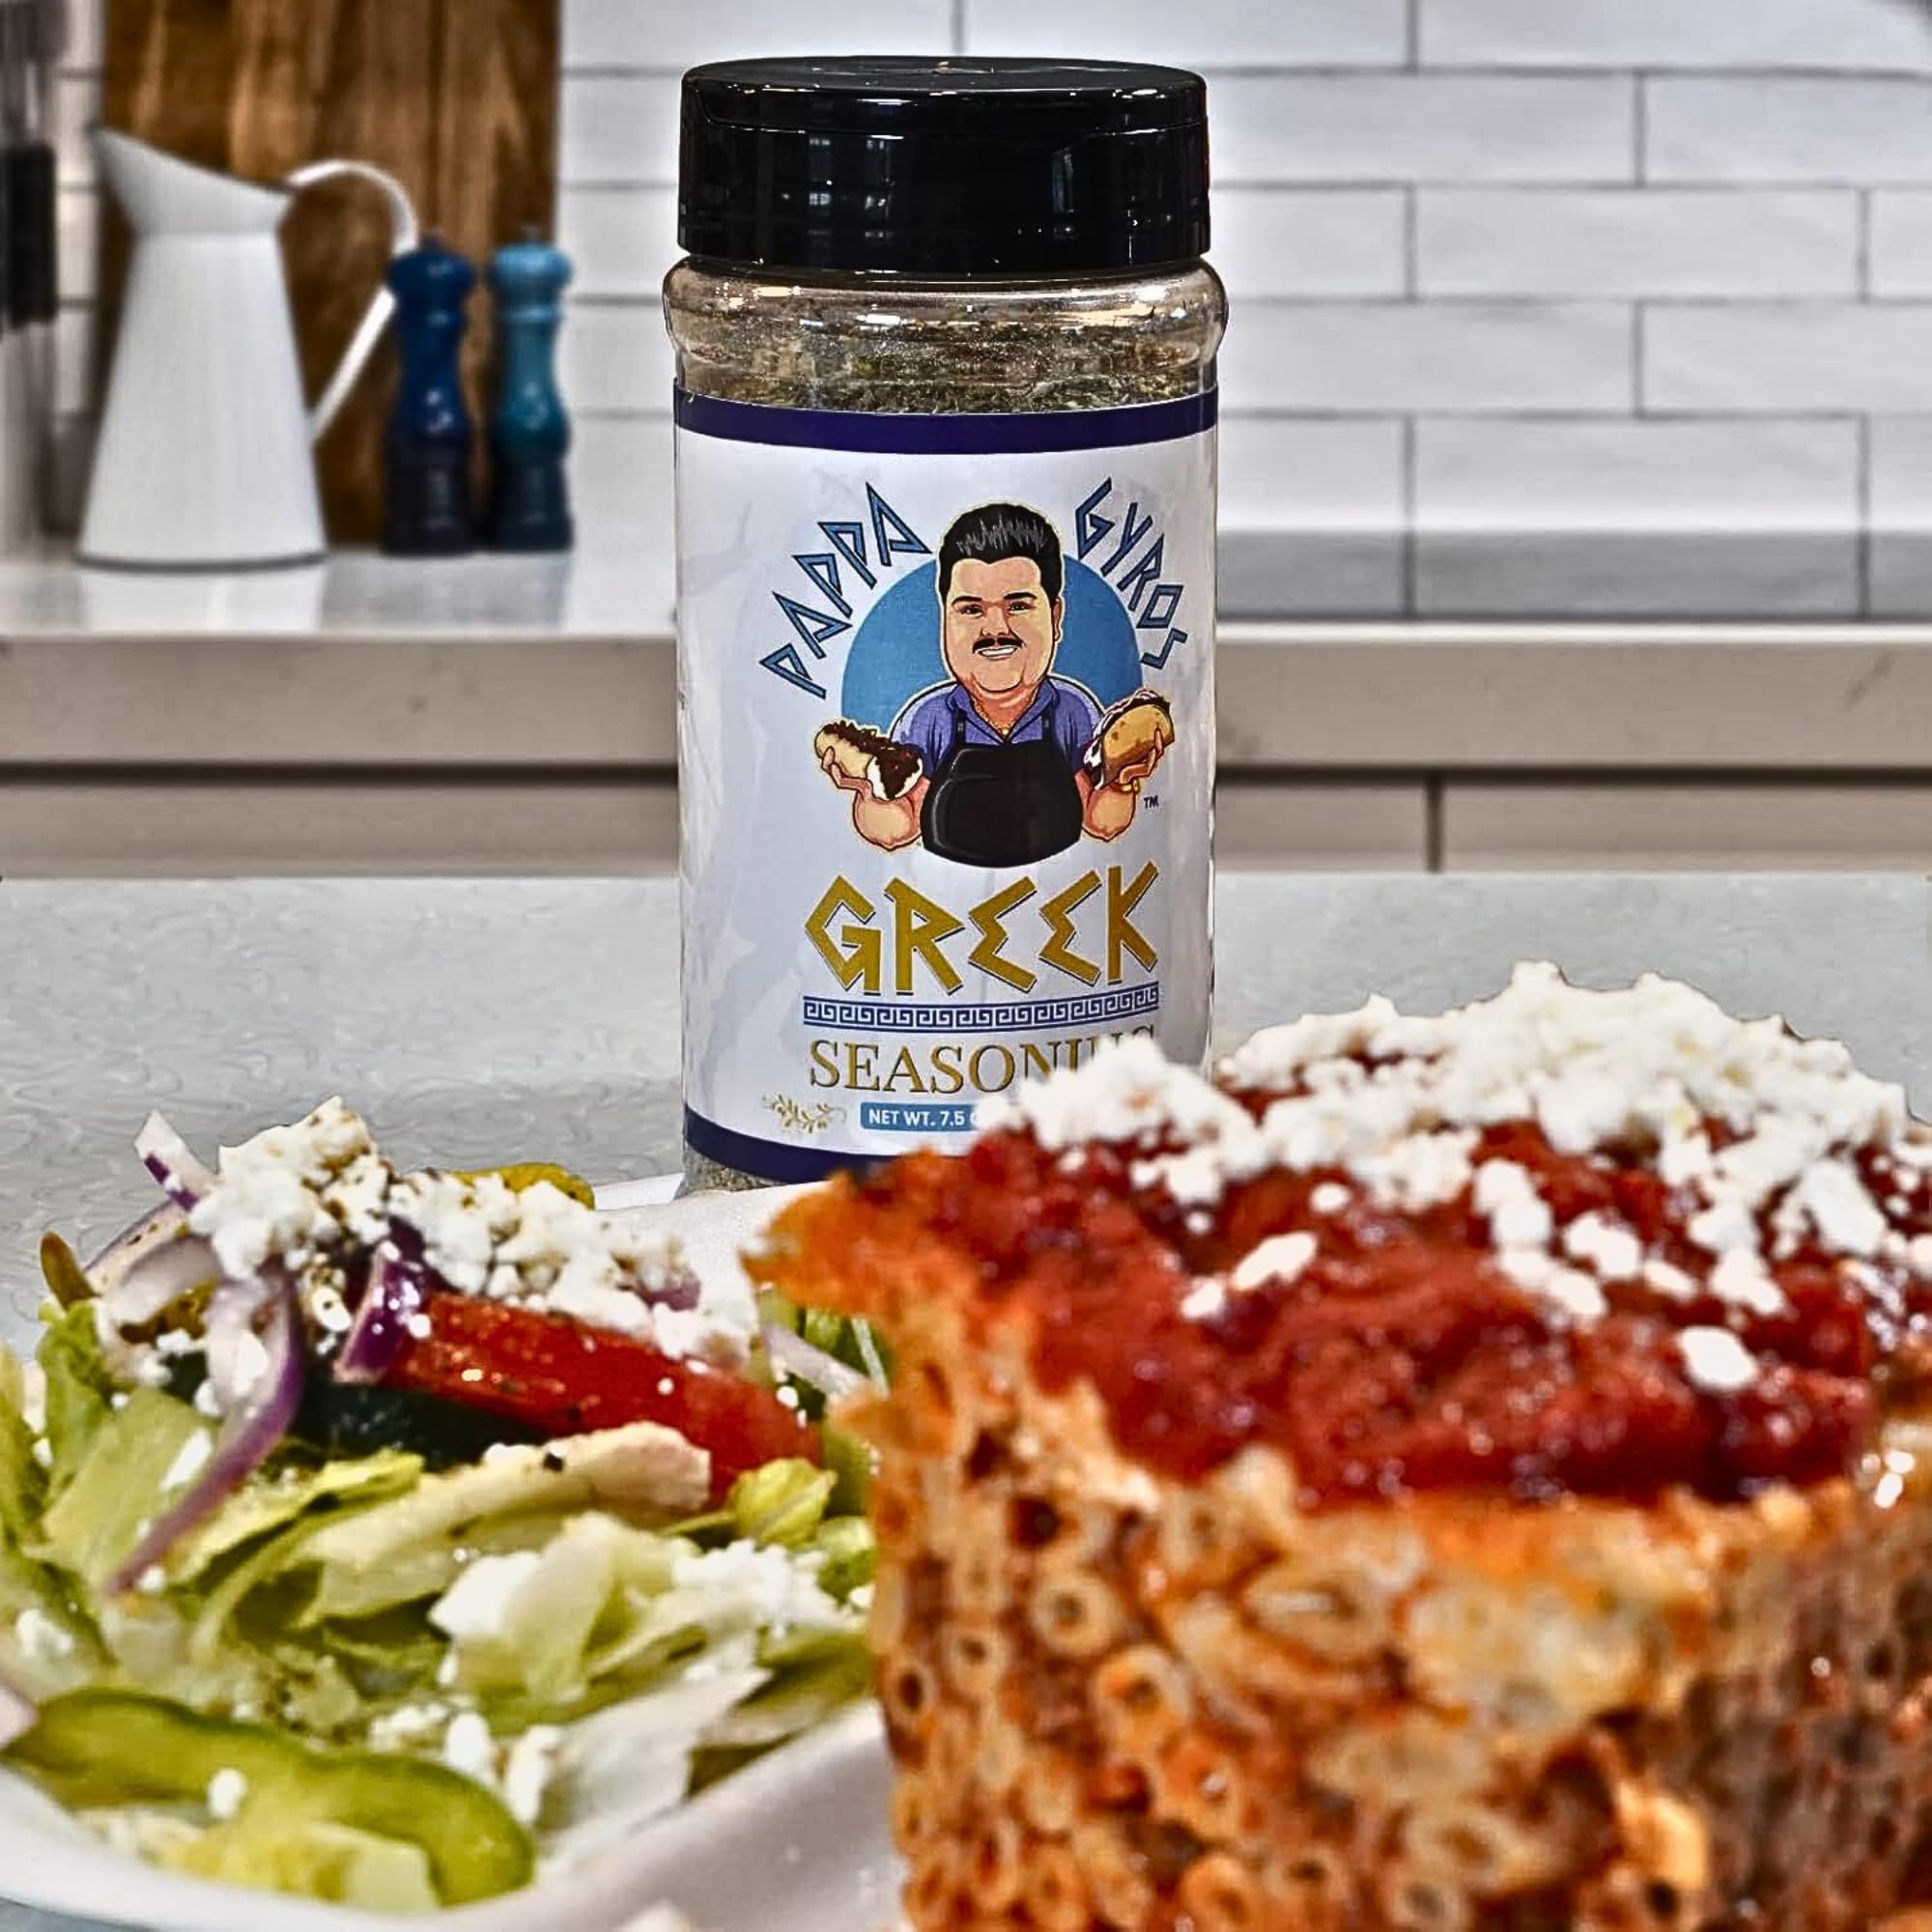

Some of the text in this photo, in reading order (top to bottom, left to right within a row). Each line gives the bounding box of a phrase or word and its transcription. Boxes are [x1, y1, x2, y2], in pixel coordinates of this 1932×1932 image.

[759, 477, 1188, 699] PAPPA GYROS
[1143, 794, 1159, 809] TM
[805, 861, 1159, 996] GREEK
[810, 1023, 1155, 1094] SEASONI
[869, 1109, 899, 1124] NET
[904, 1111, 936, 1126] WT.
[940, 1111, 965, 1126] 7.5
